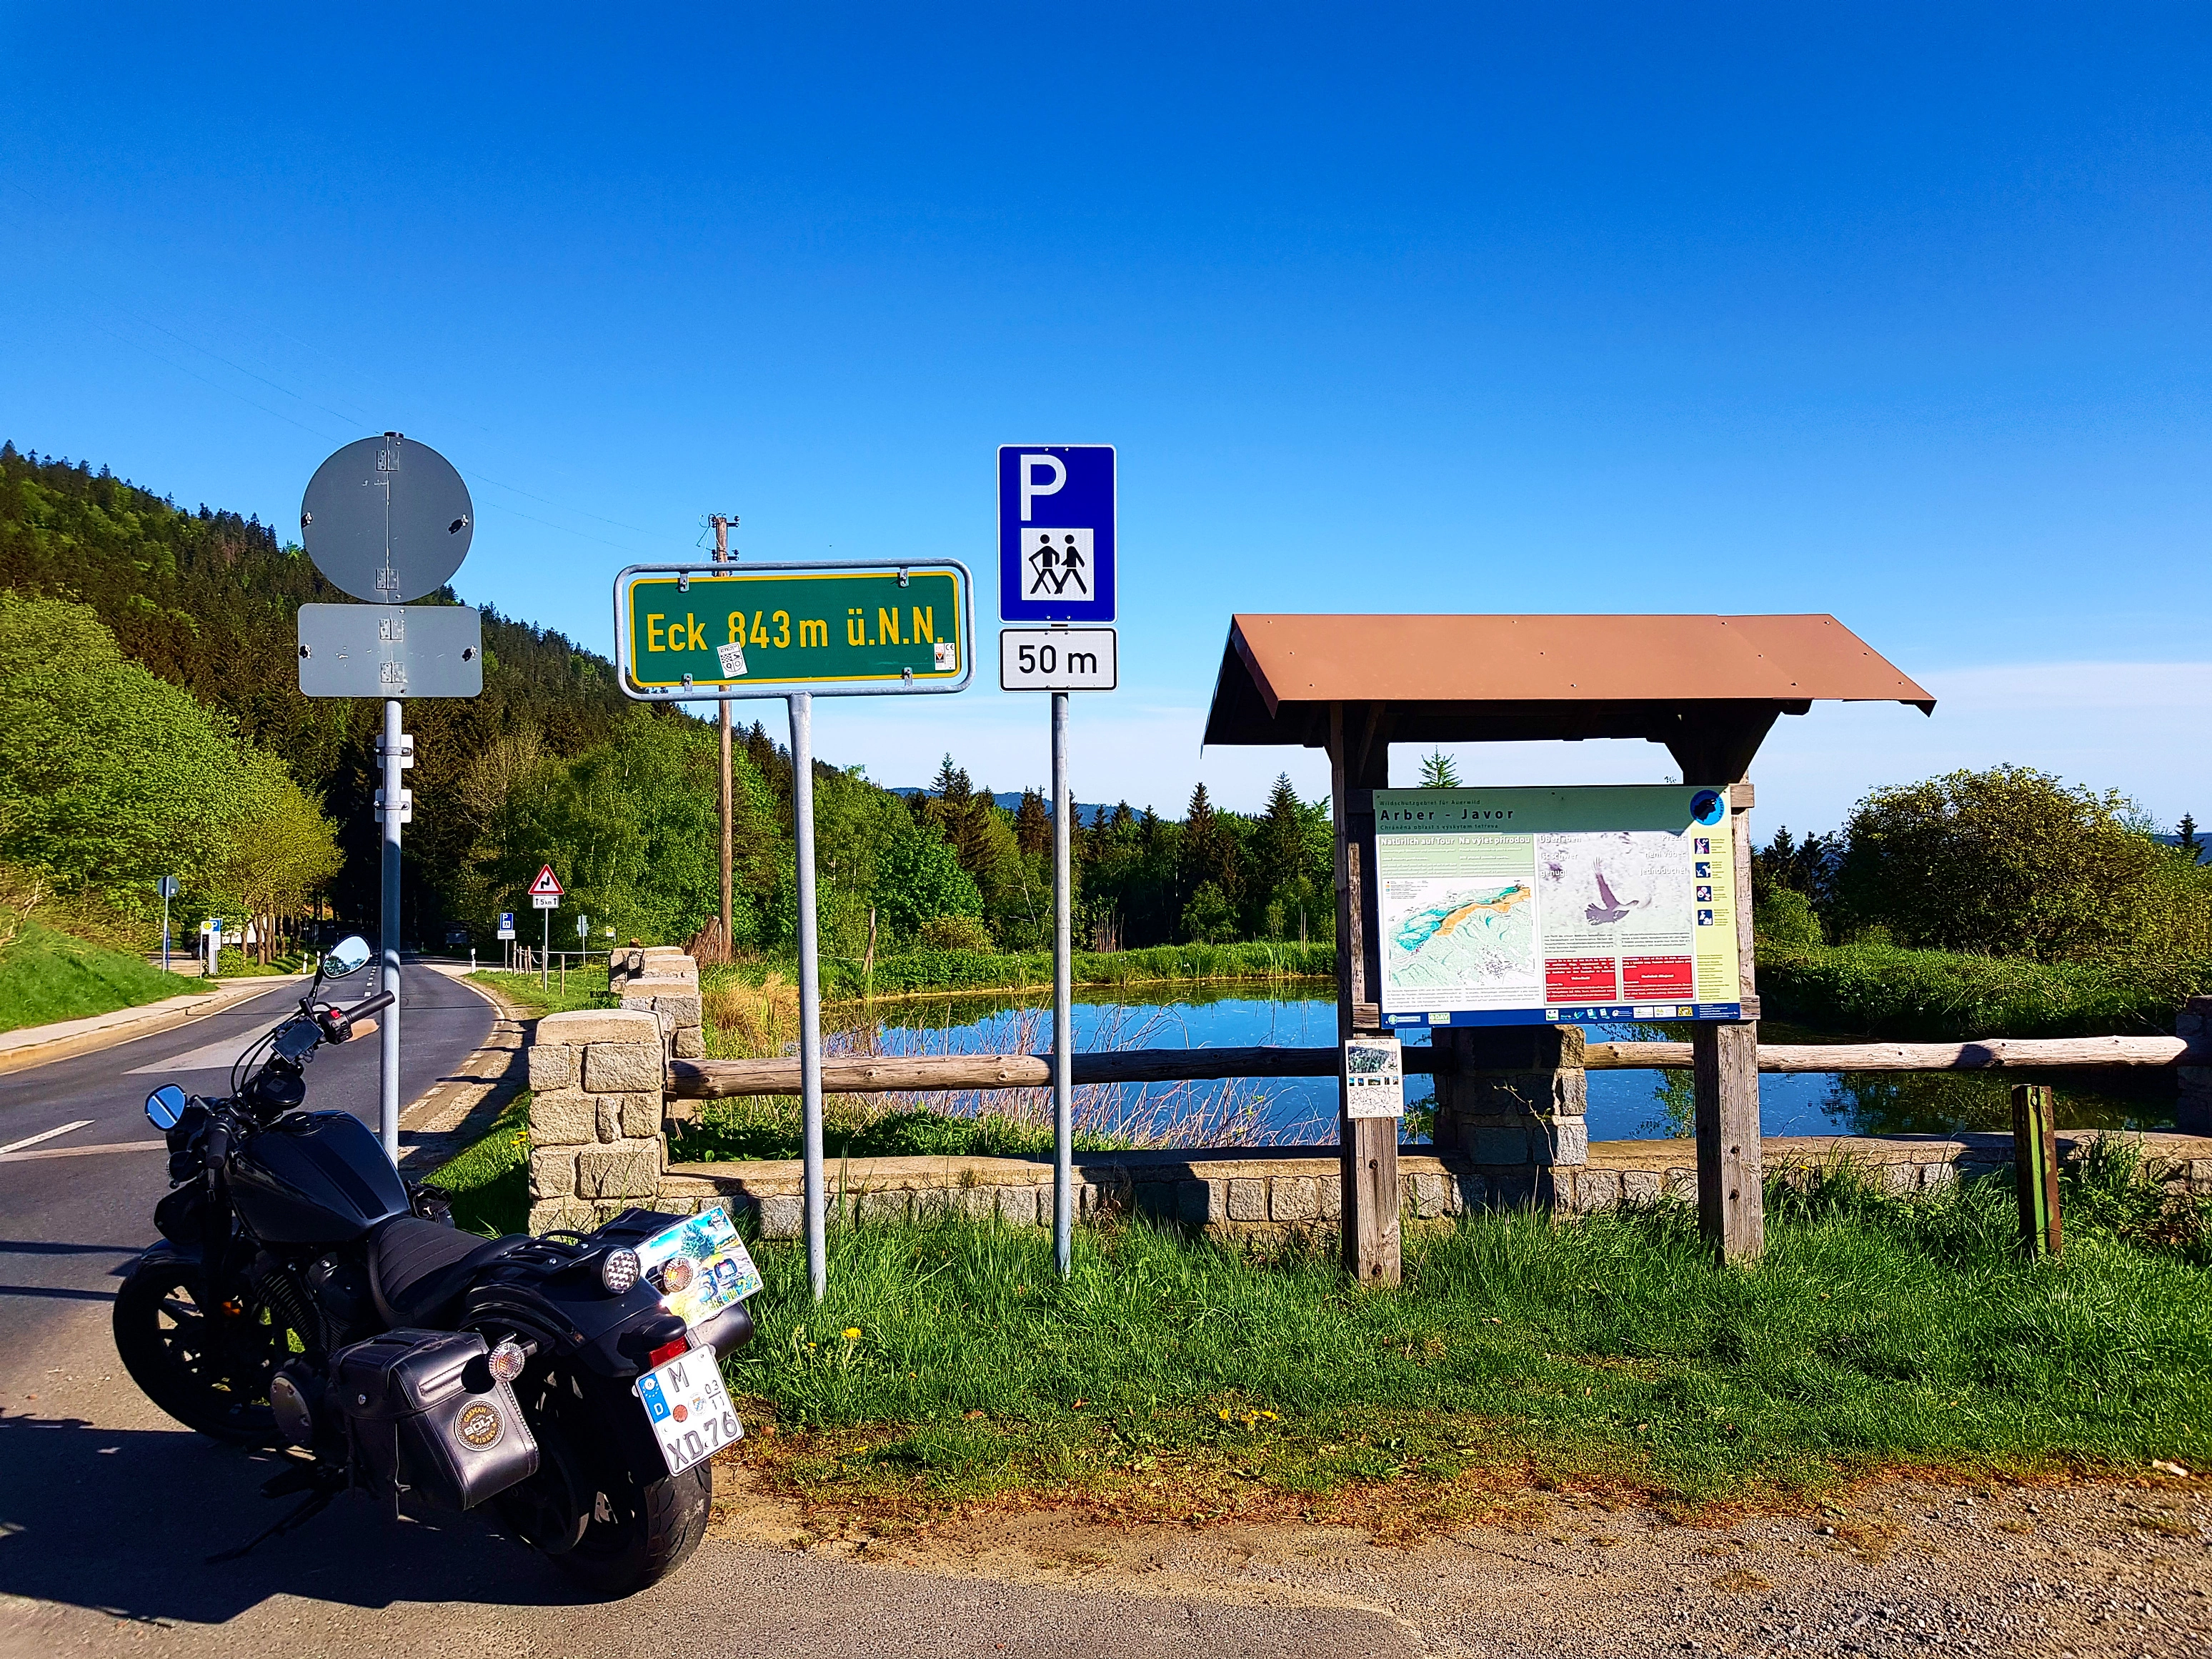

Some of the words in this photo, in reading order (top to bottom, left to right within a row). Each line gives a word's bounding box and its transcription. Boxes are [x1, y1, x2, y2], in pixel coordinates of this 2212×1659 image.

[1020, 454, 1067, 521] P
[647, 613, 708, 652] Eck
[728, 609, 791, 649] 843
[799, 619, 828, 647] m
[847, 606, 944, 647] ü.N.N.
[1019, 644, 1057, 674] 50
[1068, 652, 1097, 674] m
[1380, 809, 1435, 821] Arber
[1461, 809, 1514, 820] Javor
[1381, 837, 1420, 846] Natürlich
[1421, 837, 1435, 845] auf
[1437, 837, 1455, 845] Tour
[1471, 837, 1493, 847] výlet
[1494, 836, 1530, 845] přírodou
[1539, 835, 1582, 844] Überleben
[1550, 852, 1578, 861] schwer
[212, 921, 218, 932] P
[667, 1362, 689, 1393] M
[704, 1380, 719, 1395] 03
[654, 1403, 664, 1416] D
[712, 1395, 725, 1410] 11
[464, 1407, 487, 1423] GERMAN
[464, 1413, 495, 1437] BOLT
[475, 1430, 496, 1443] RIDERS
[667, 1430, 704, 1470] XD
[704, 1411, 737, 1447] 76
